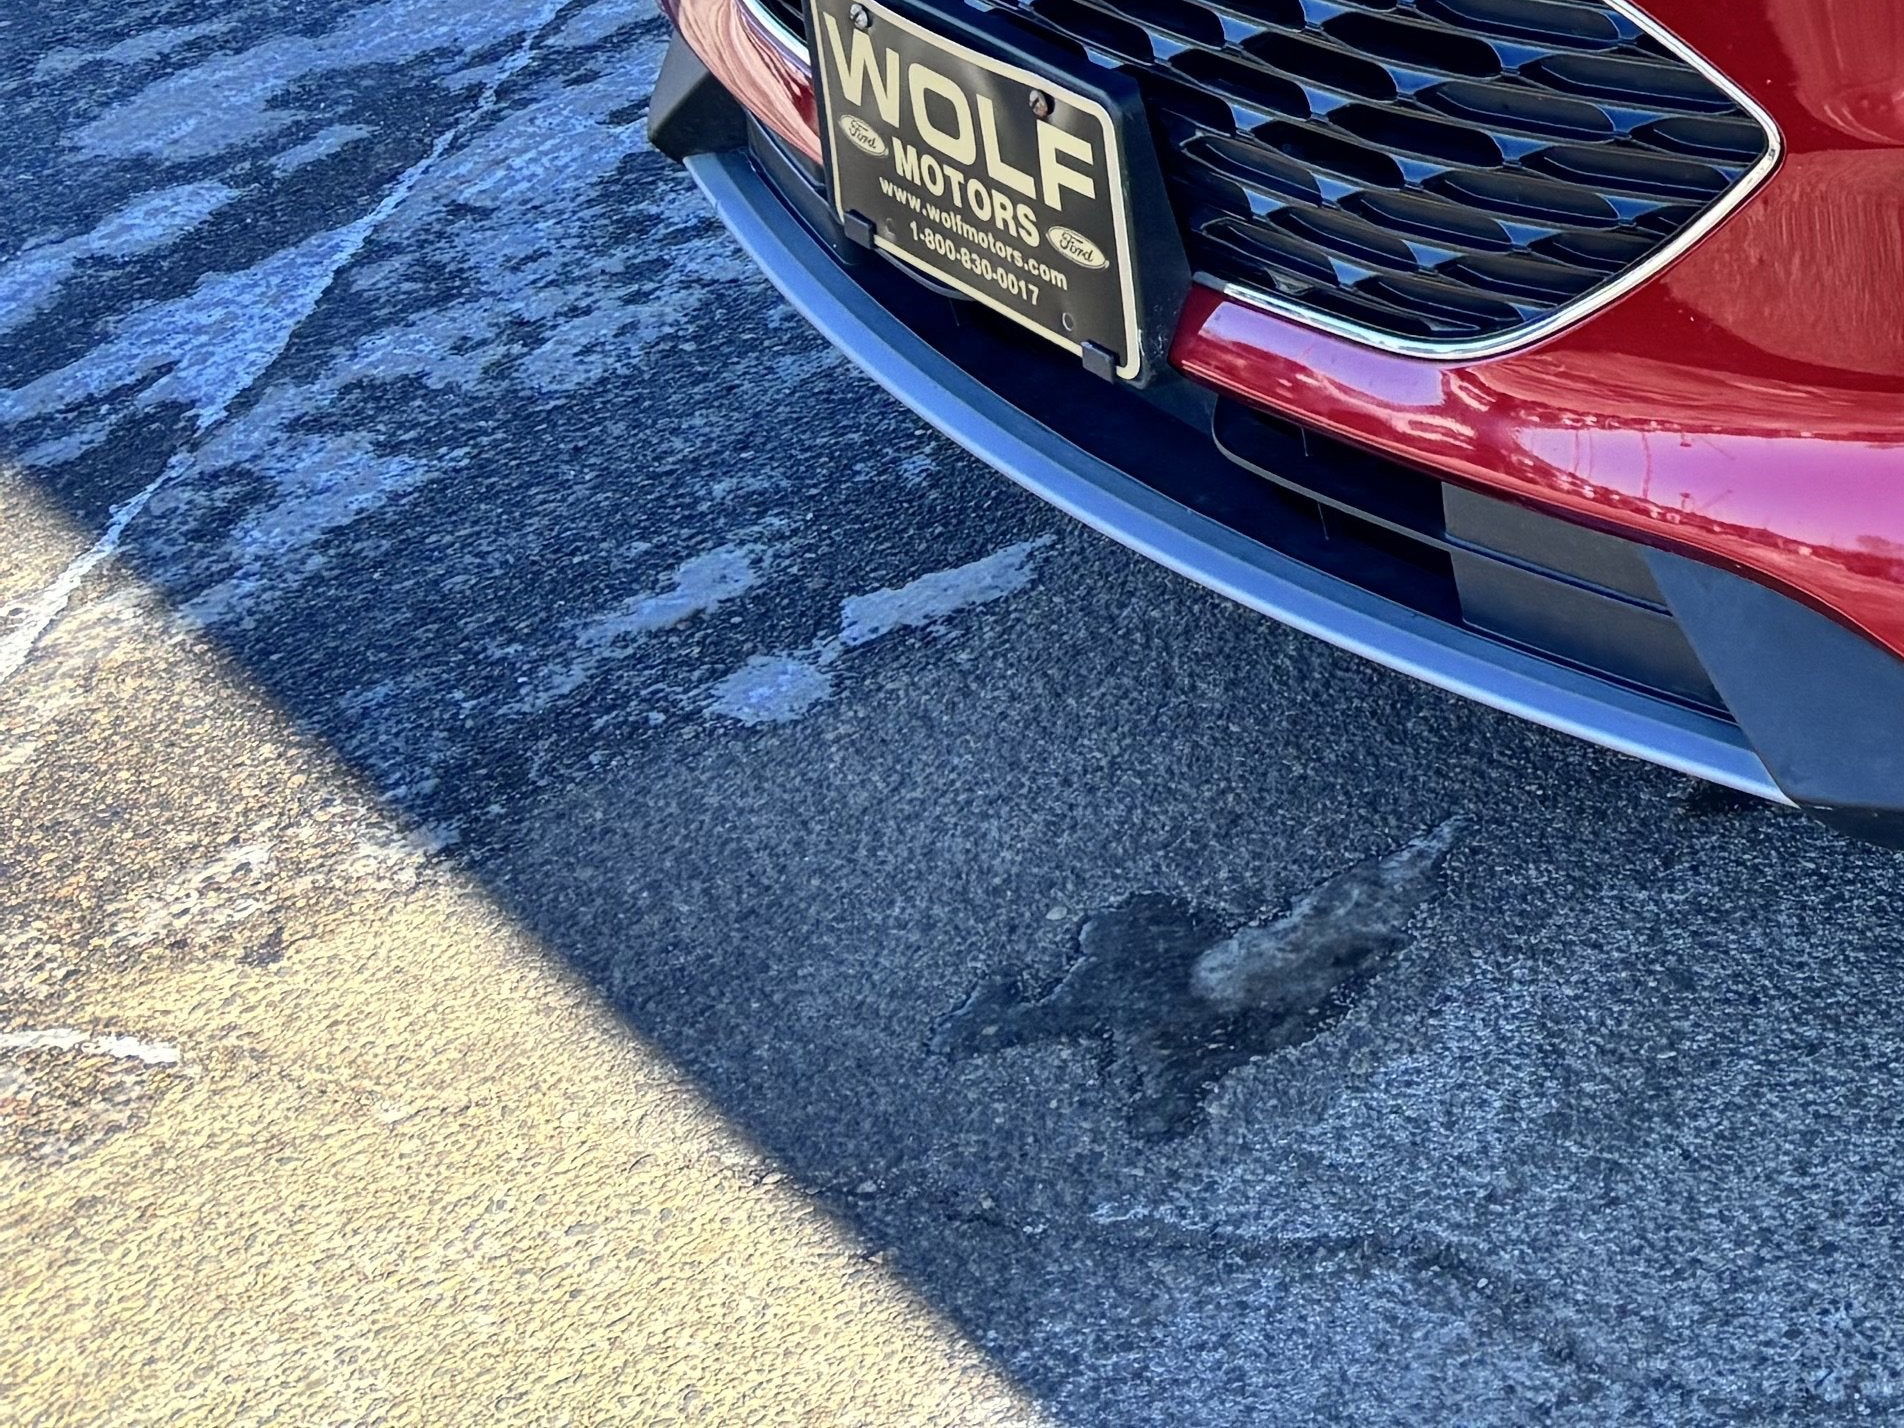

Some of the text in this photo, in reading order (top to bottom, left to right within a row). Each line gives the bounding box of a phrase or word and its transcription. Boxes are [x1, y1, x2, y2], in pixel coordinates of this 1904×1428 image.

[822, 11, 1096, 212] WOLF
[879, 176, 1068, 291] www.wolfmotors.com
[891, 136, 1041, 248] MOTORS
[909, 221, 1040, 306] 1-800-830-0017
